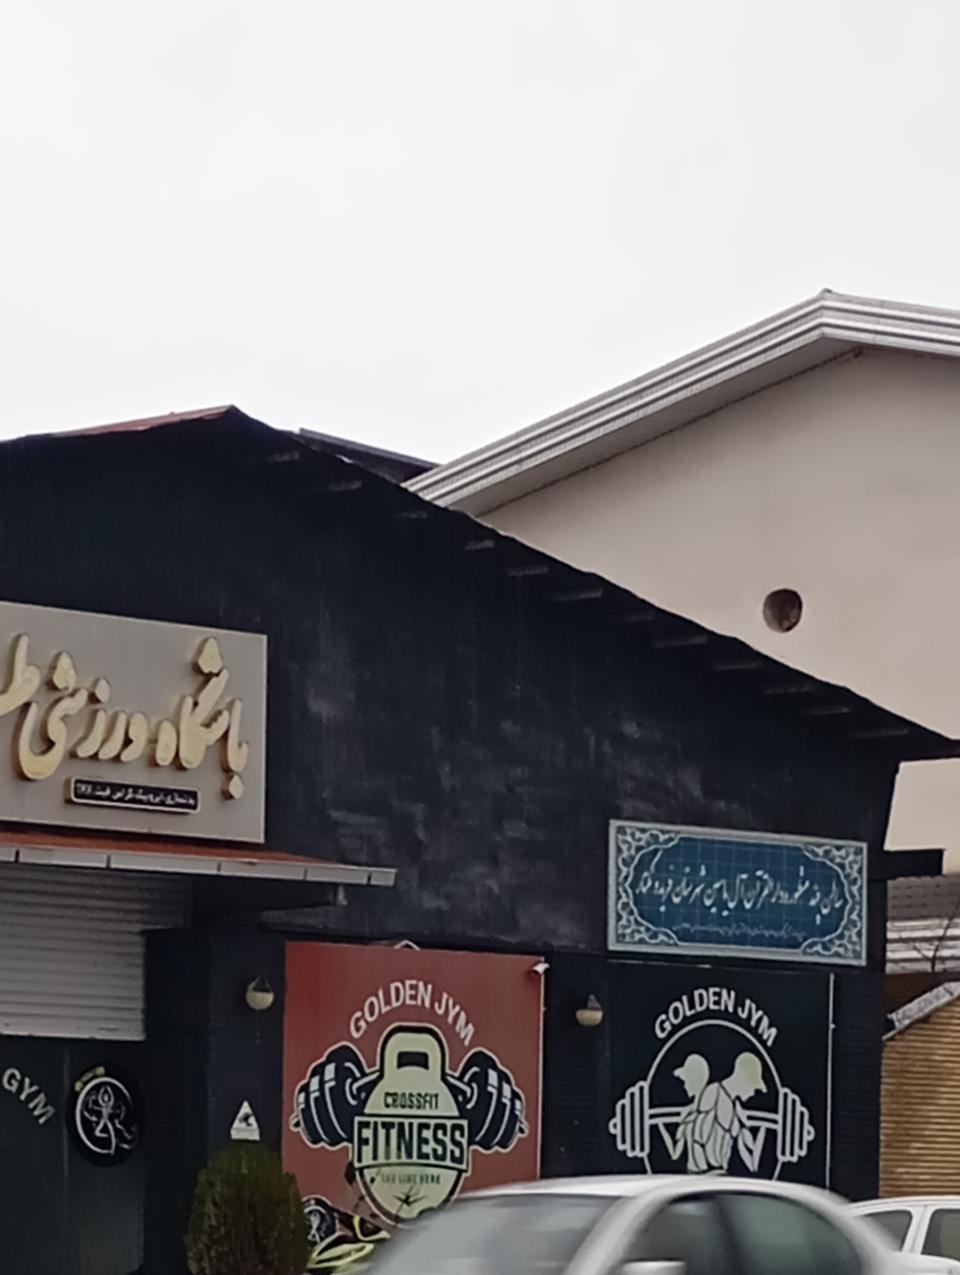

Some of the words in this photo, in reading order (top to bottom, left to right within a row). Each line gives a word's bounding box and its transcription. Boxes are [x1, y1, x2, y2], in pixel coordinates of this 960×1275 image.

[17, 650, 149, 780] ورزشی
[154, 636, 248, 799] باشگاه
[349, 979, 433, 1039] GOLDEN
[434, 991, 475, 1047] JYM
[654, 986, 736, 1039] GOLDEN
[737, 998, 778, 1048] JYM
[1, 1067, 56, 1125] GYM
[383, 1091, 439, 1110] CROSSFIT
[356, 1120, 465, 1166] FITNESS
